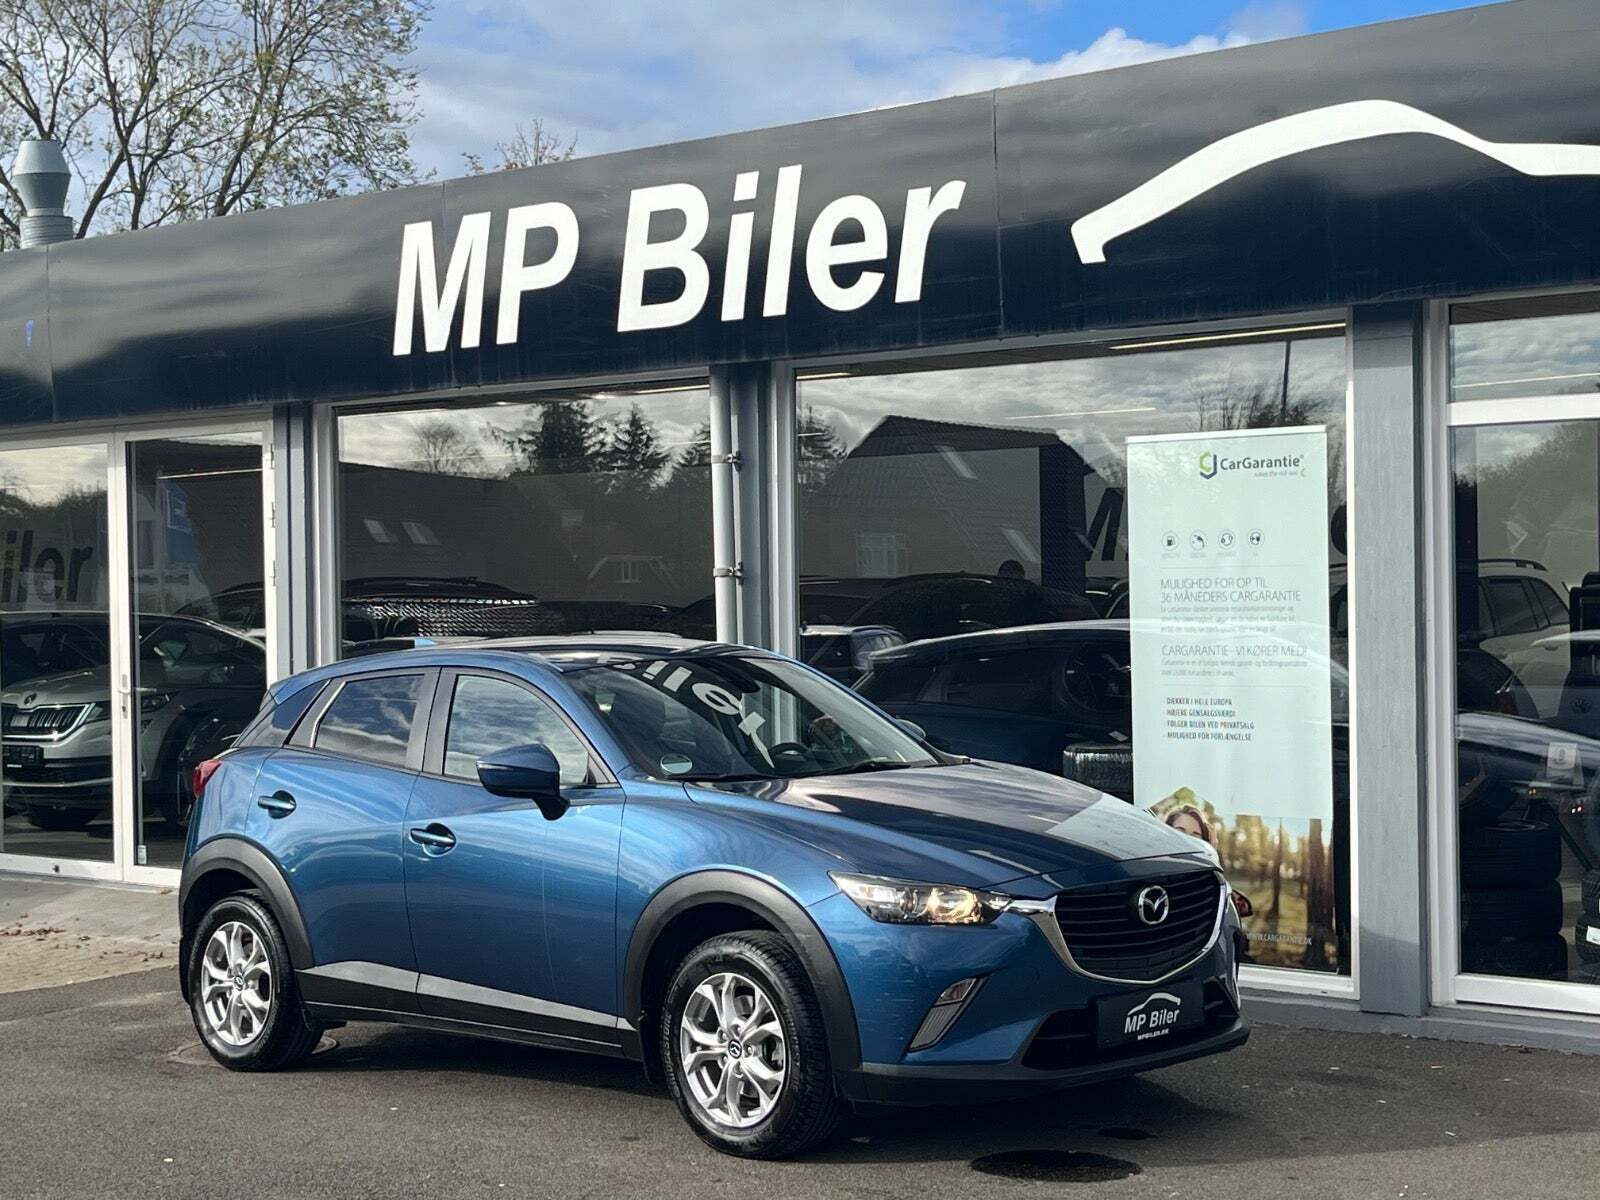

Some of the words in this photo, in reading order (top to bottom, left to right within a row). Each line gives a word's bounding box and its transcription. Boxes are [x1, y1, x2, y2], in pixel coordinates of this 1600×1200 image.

[393, 202, 580, 356] MP
[617, 164, 967, 333] Biler
[1219, 454, 1301, 471] CarGarantie
[1160, 577, 1213, 590] MULIGHED
[1214, 577, 1234, 589] FOR
[1236, 577, 1252, 589] OP
[1254, 576, 1269, 588] TIL
[1174, 590, 1228, 603] MÅNEDERS
[1229, 590, 1302, 602] CARGARANTIE
[1161, 644, 1230, 657] CARGARANTIE
[1124, 1013, 1147, 1034] MP
[1149, 1008, 1180, 1028] Biler
